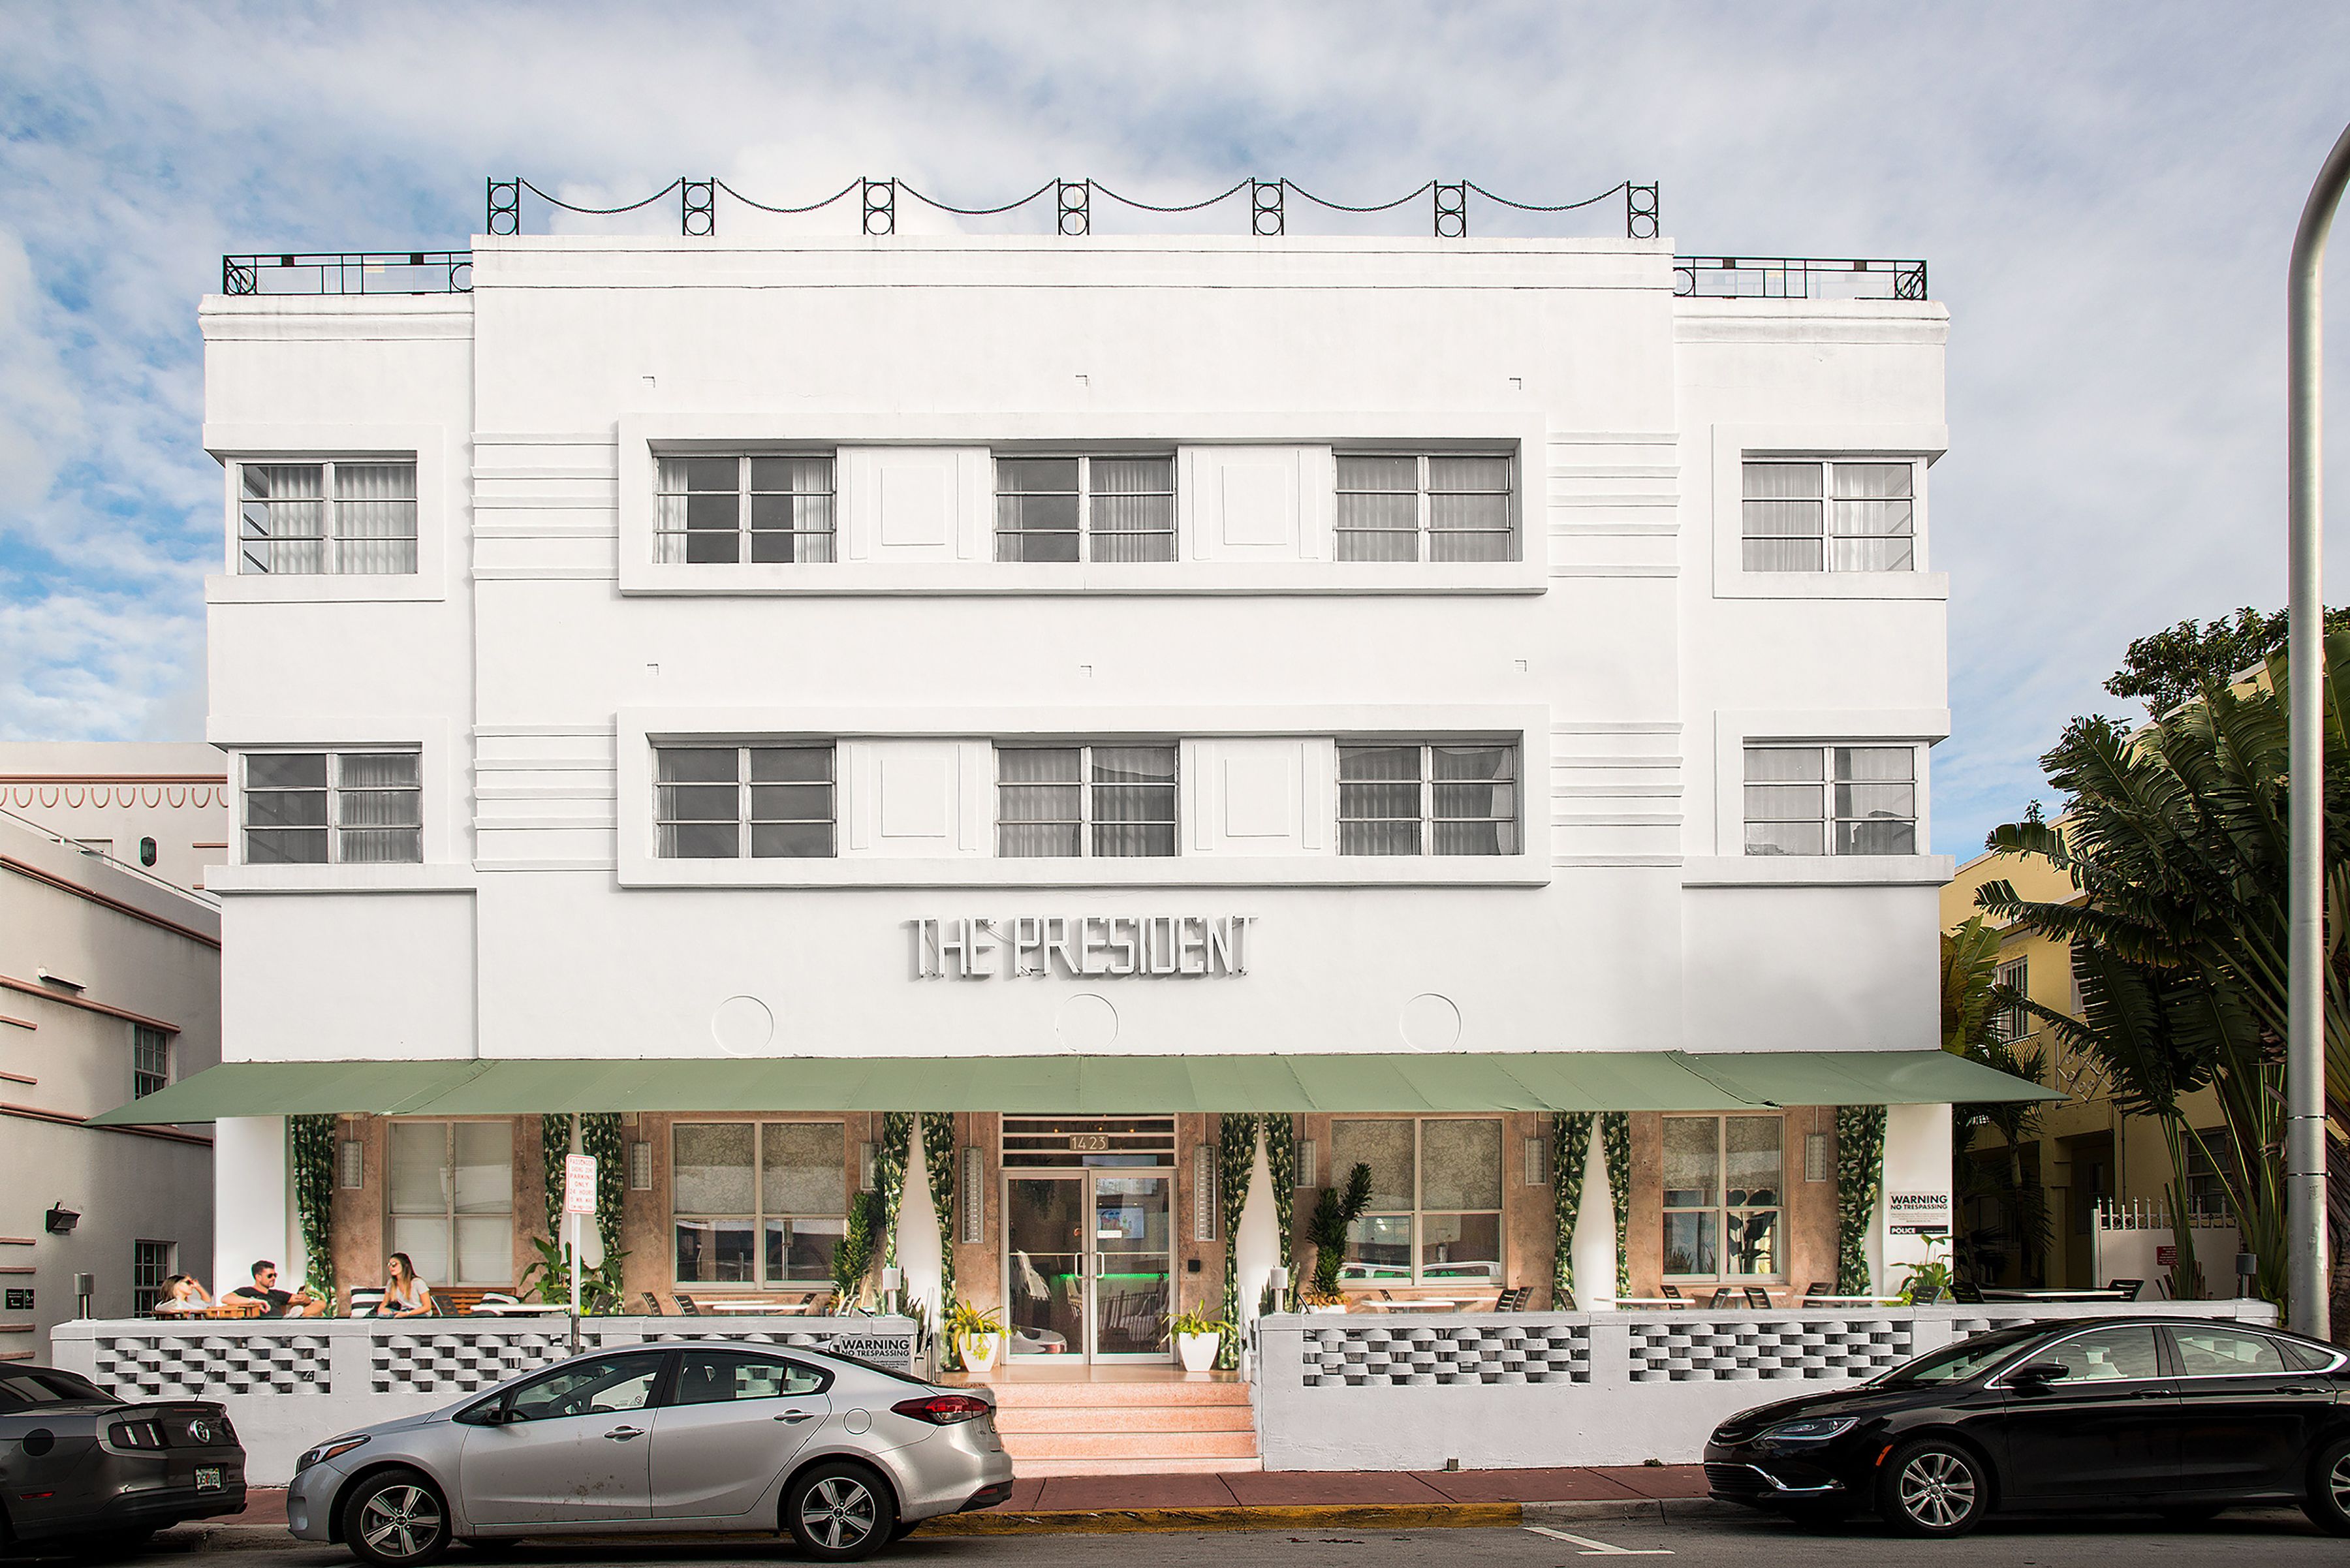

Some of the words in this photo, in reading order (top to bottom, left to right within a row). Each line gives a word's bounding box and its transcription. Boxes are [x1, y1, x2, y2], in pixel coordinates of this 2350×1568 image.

[909, 916, 996, 977] THE
[1014, 915, 1259, 976] PRESIDENT
[1072, 1136, 1106, 1150] 1423
[570, 1172, 593, 1181] PARKING
[1891, 1195, 1948, 1204] WARNING
[842, 1340, 910, 1350] WARNING
